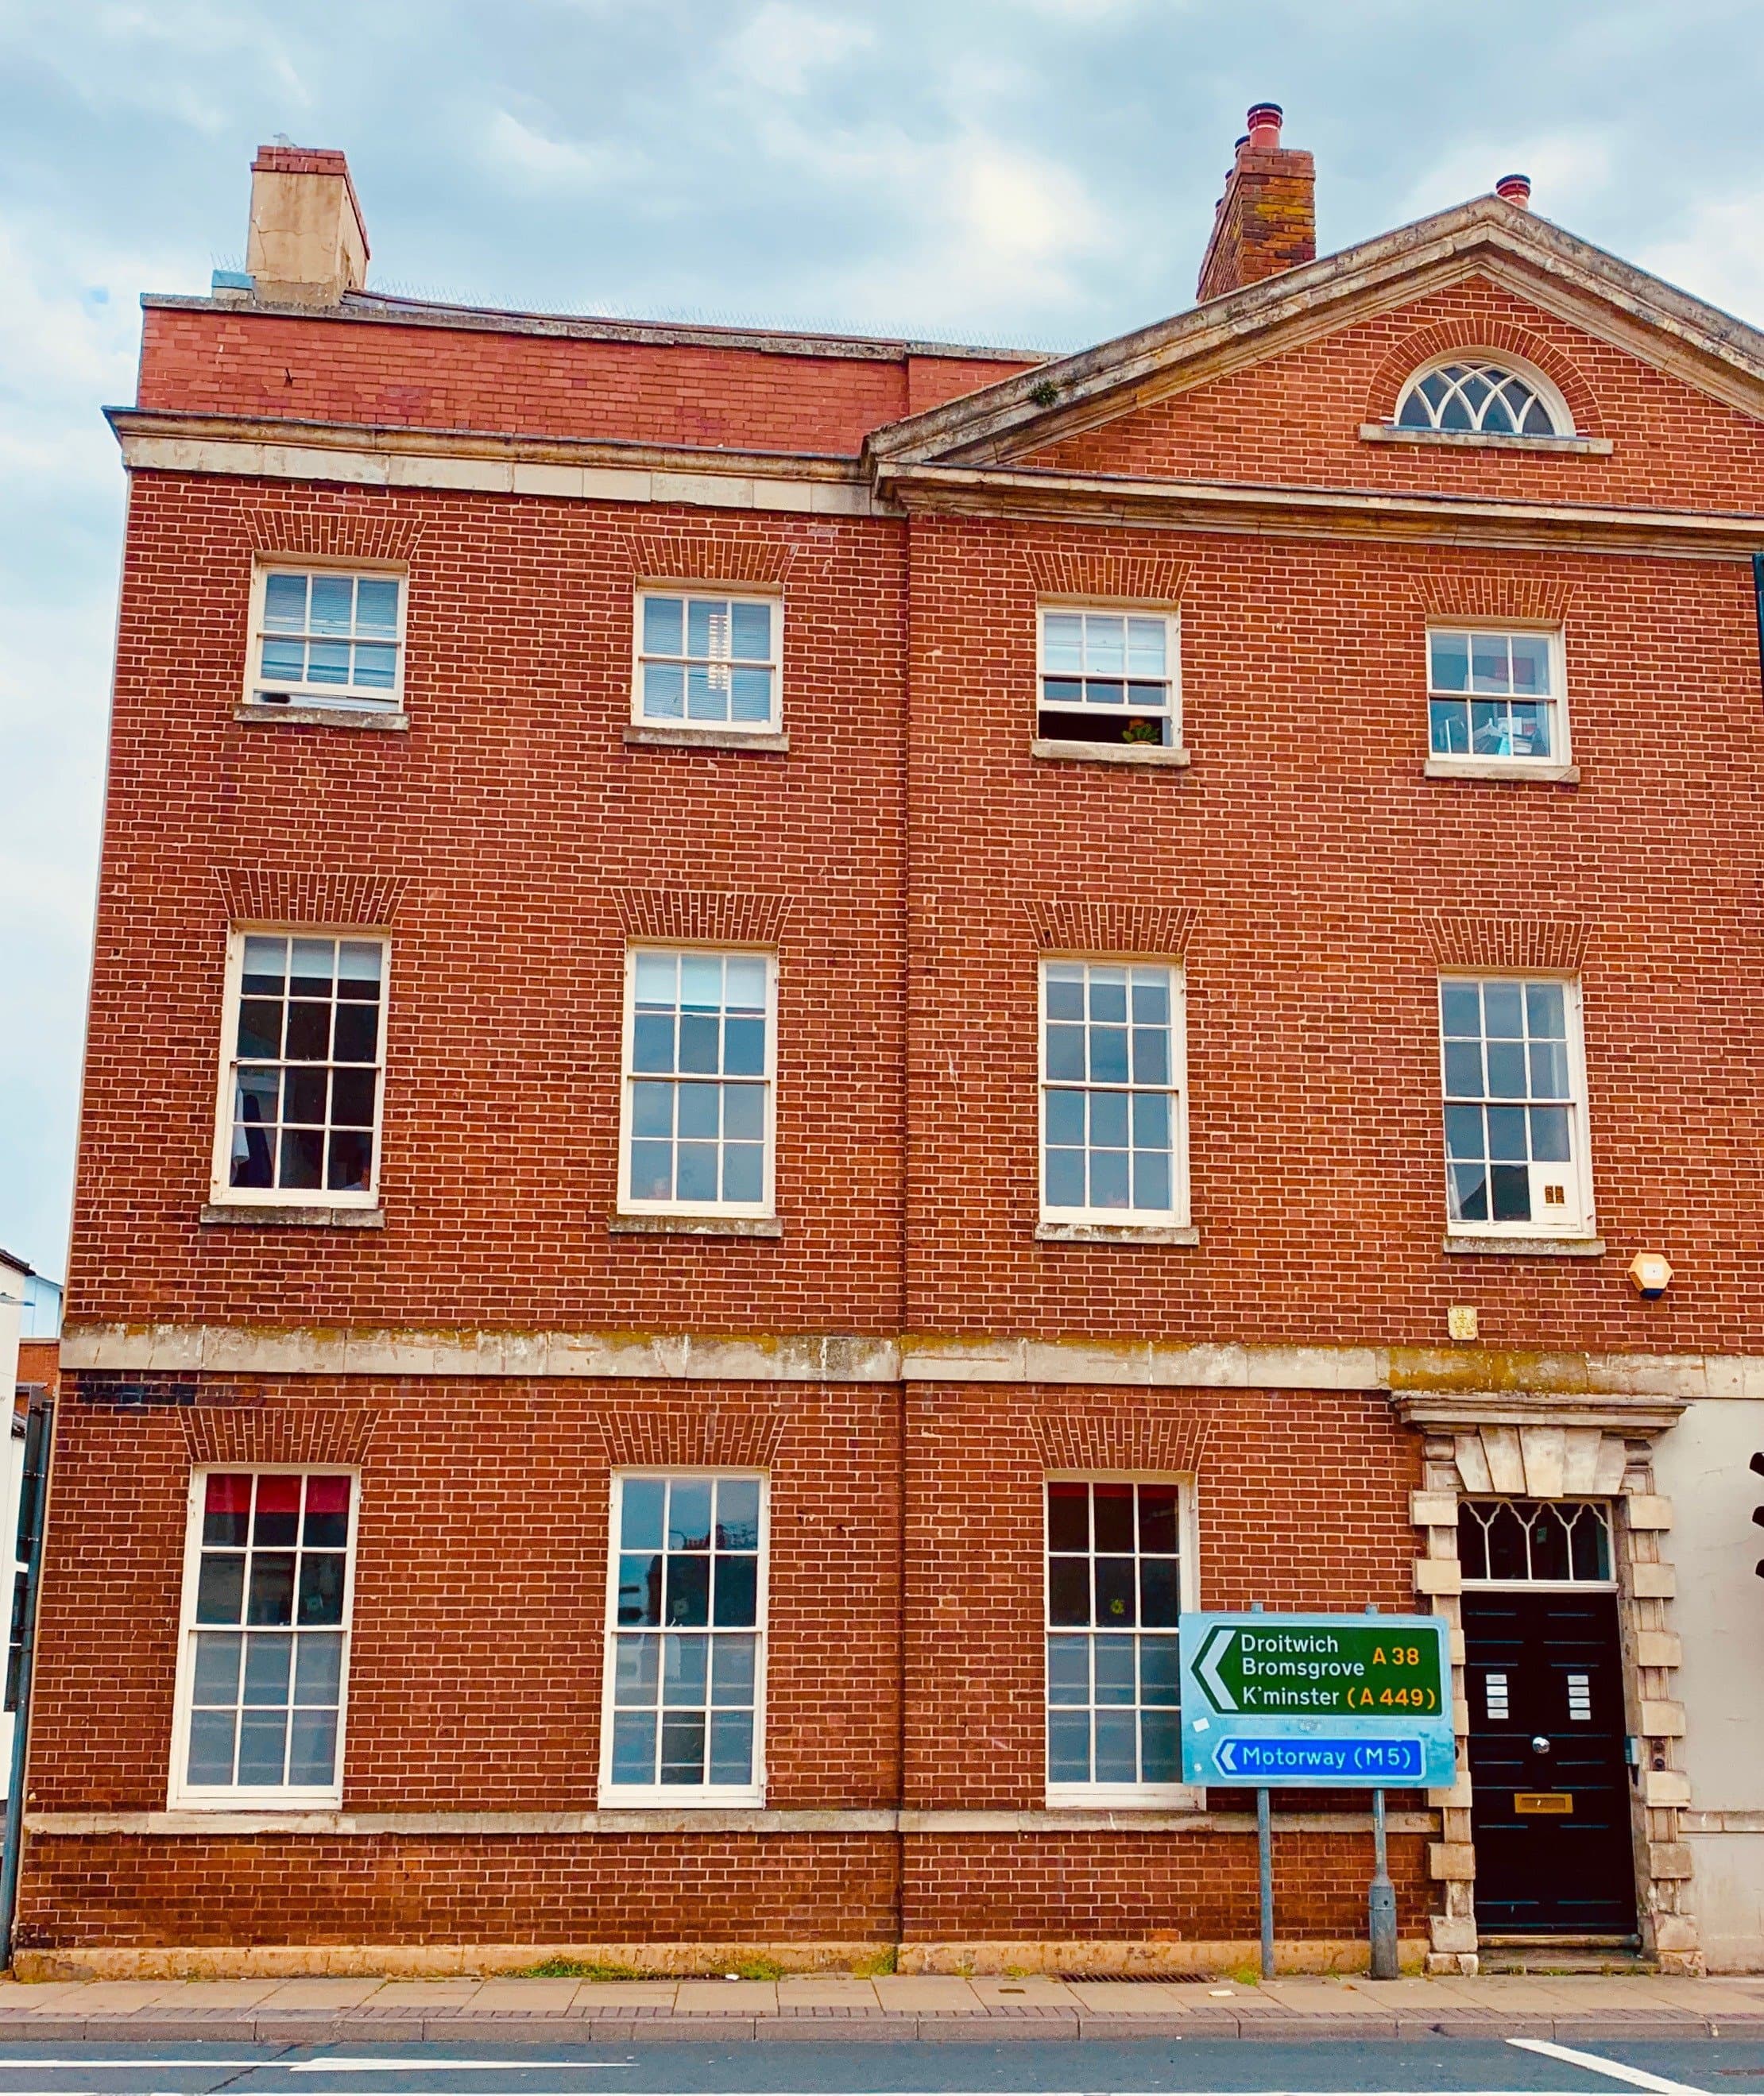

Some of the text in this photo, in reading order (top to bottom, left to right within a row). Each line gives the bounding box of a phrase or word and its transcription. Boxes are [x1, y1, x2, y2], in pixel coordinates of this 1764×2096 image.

[1241, 1634, 1338, 1652] Droitwich
[1242, 1658, 1364, 1679] Bromsgrove
[1243, 1686, 1339, 1705] K'minster
[1243, 1747, 1345, 1769] Motorway
